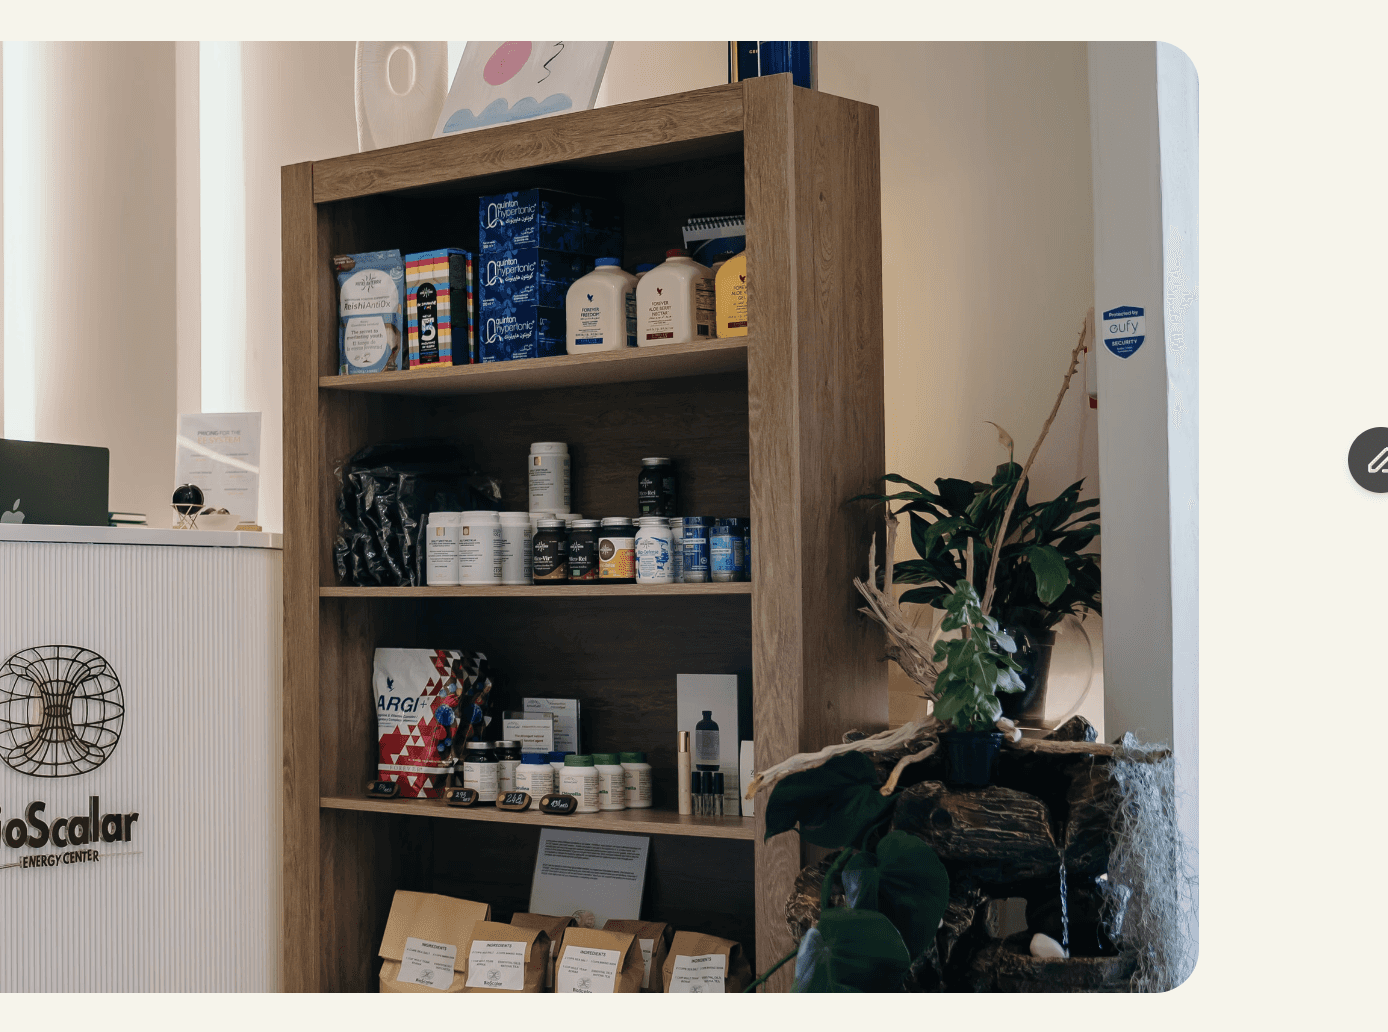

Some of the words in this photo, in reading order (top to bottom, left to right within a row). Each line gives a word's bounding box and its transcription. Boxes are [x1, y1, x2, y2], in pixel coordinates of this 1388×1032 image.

[497, 200, 518, 209] quinton
[496, 258, 517, 267] quinton
[495, 316, 516, 325] quinton
[421, 318, 436, 341] 5
[1109, 320, 1139, 335] eufy
[1111, 339, 1138, 347] SECURITY
[20, 853, 61, 869] ENERGY
[62, 849, 100, 865] CENTER
[422, 943, 447, 951] INGREDIENTS
